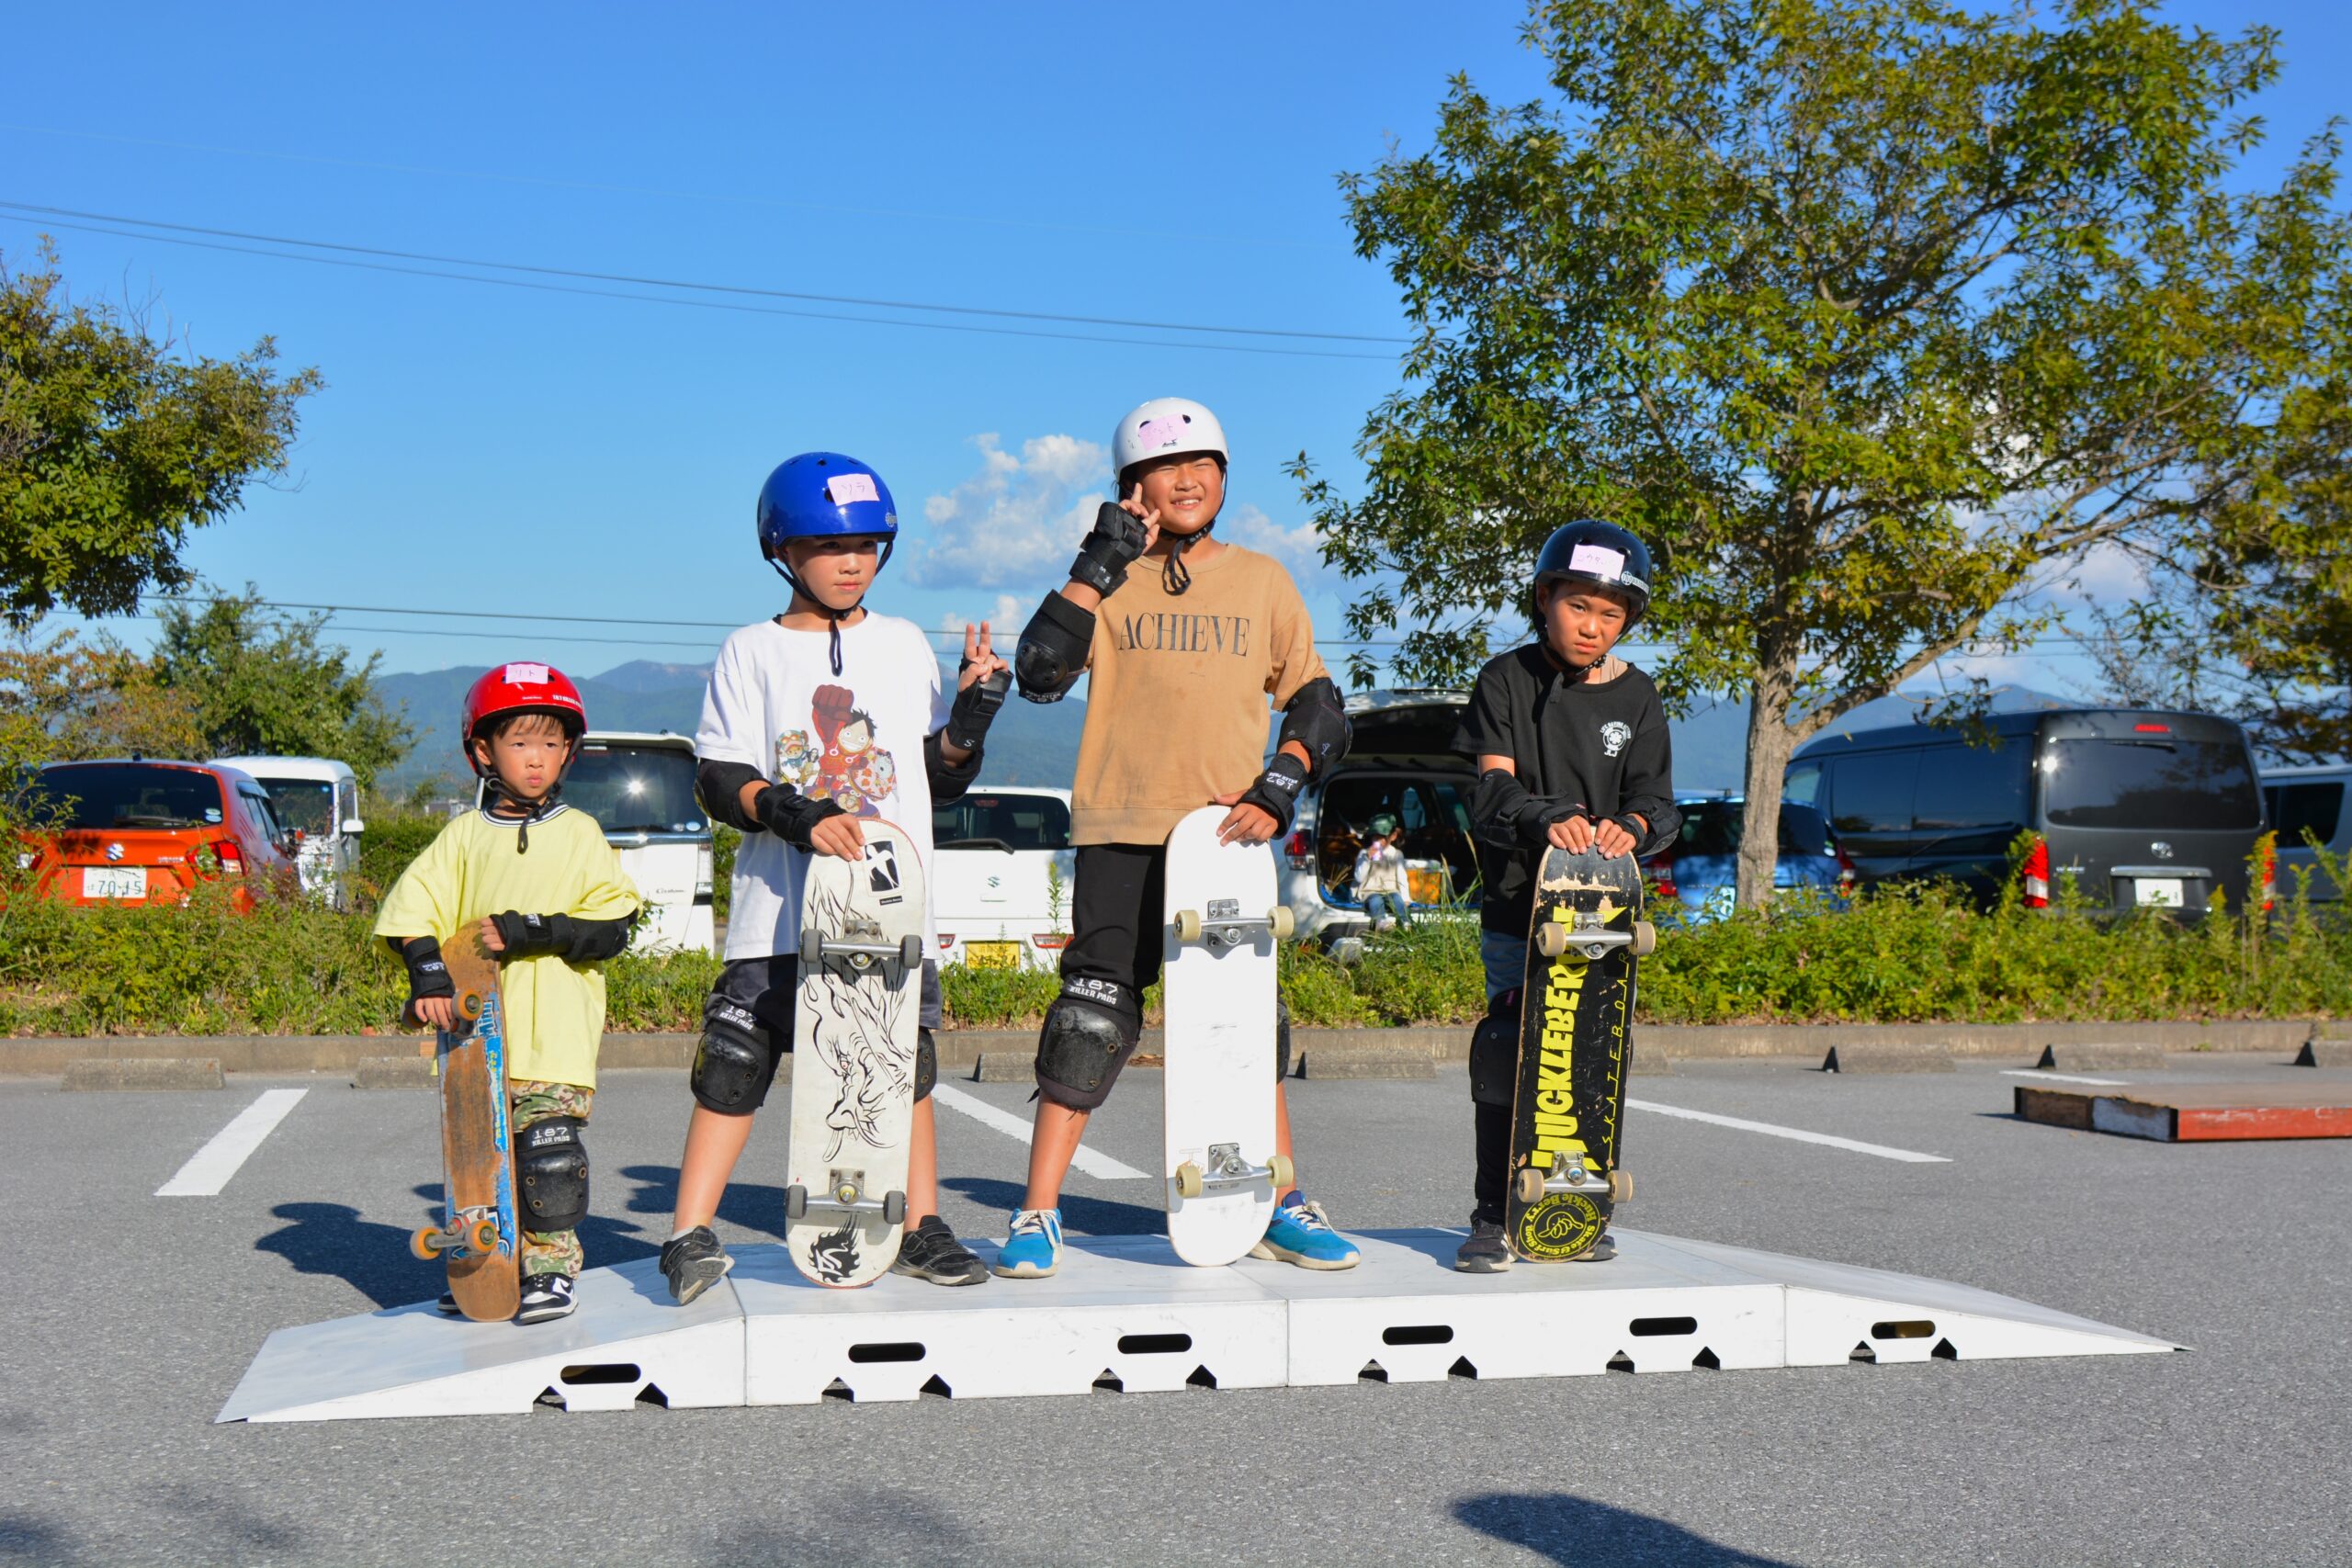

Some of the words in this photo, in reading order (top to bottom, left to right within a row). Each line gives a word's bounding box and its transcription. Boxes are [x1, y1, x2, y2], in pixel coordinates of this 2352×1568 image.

[1117, 613, 1250, 657] ACHIEVE
[1068, 985, 1096, 998] KILLER
[1096, 992, 1117, 1005] PADS
[1075, 977, 1118, 995] 187
[726, 1005, 756, 1022] 187
[534, 1126, 568, 1139] 187
[1525, 1194, 1560, 1223] Berry
[1525, 1224, 1538, 1247] Shop
[1570, 1224, 1596, 1249] Skate
[1533, 1244, 1560, 1255] Surf
